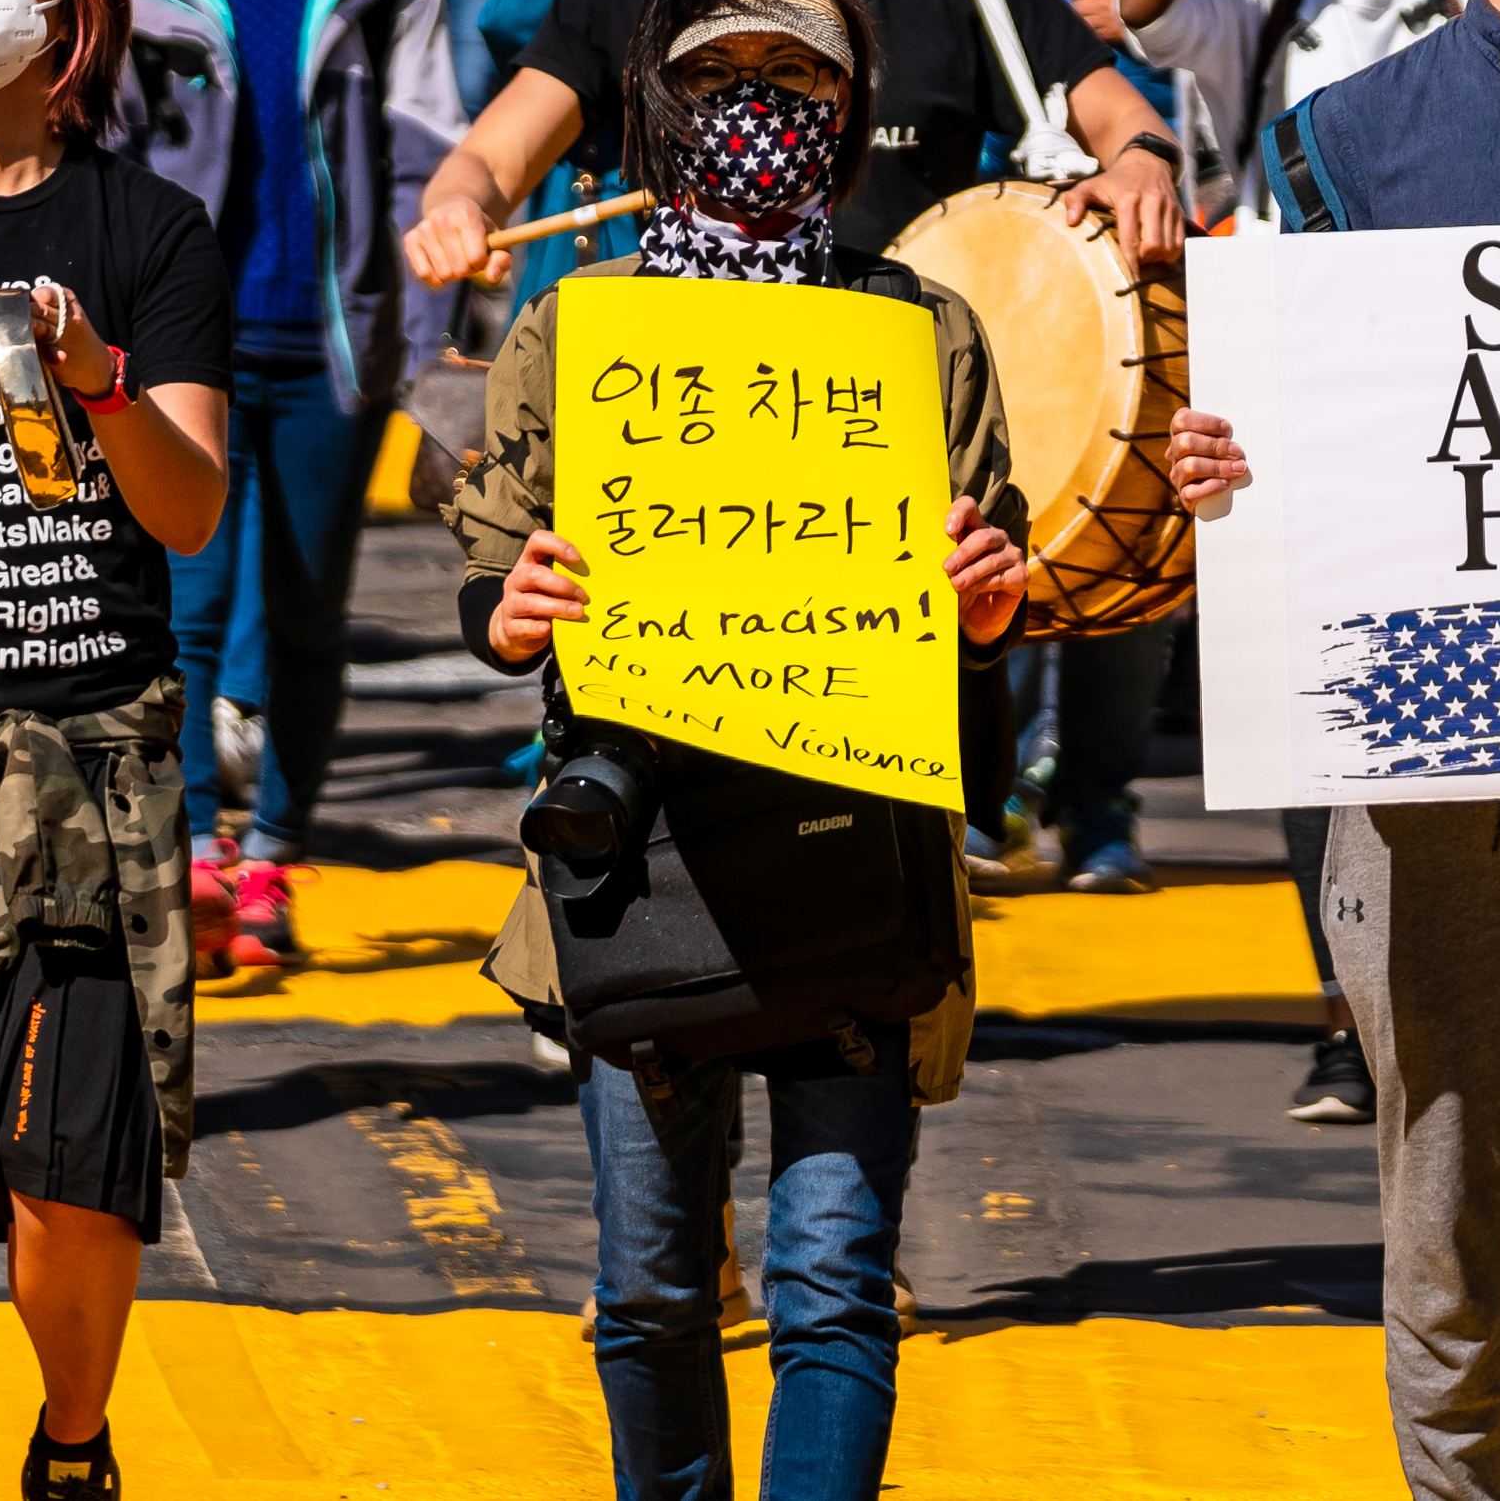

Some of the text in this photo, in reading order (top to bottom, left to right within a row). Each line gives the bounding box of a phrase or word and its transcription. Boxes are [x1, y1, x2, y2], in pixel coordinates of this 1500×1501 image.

[591, 354, 889, 448] 인종 차별
[601, 601, 696, 640] End
[765, 721, 959, 780] Violence
